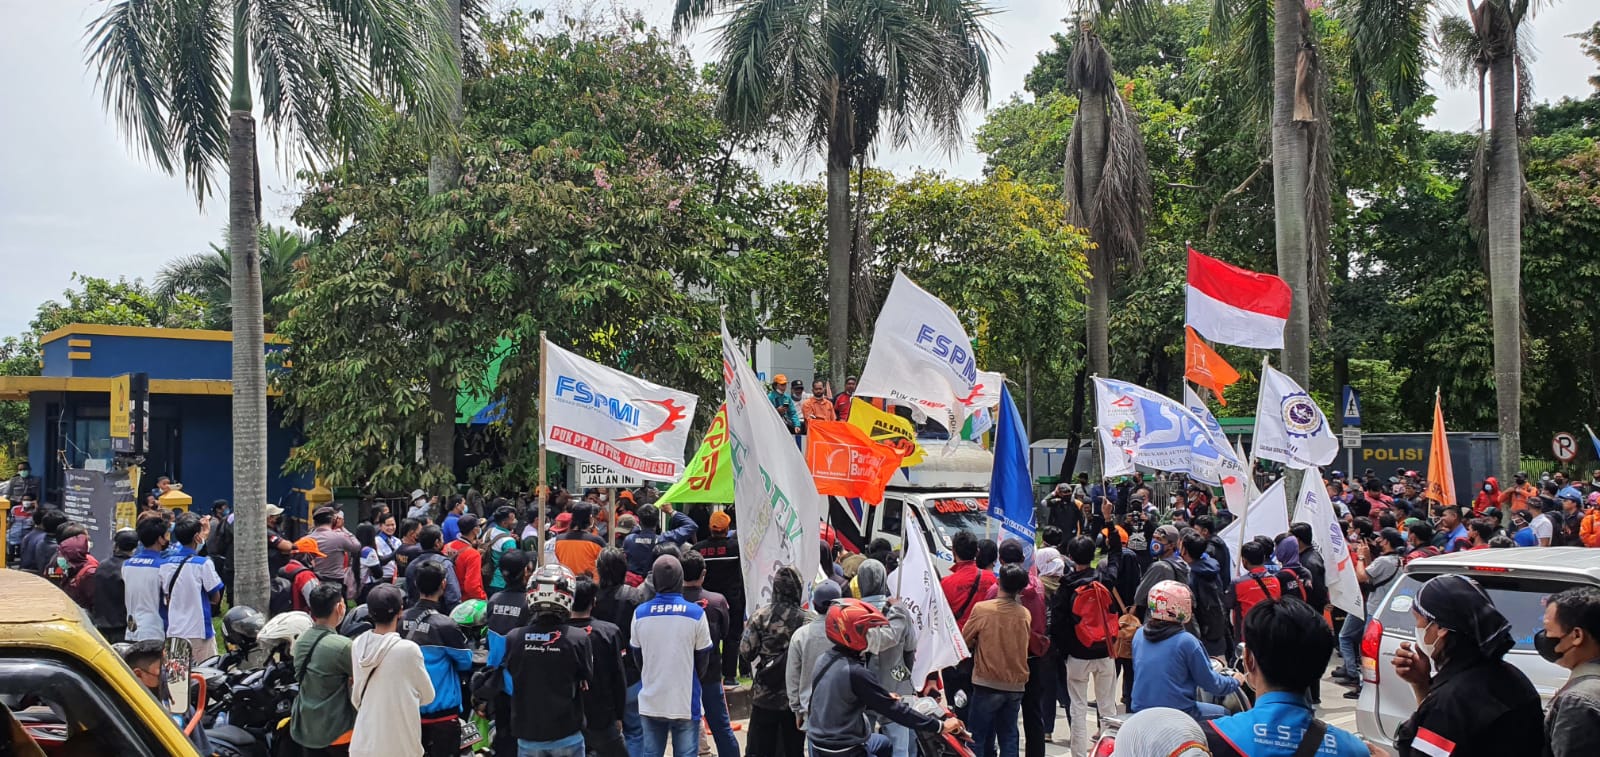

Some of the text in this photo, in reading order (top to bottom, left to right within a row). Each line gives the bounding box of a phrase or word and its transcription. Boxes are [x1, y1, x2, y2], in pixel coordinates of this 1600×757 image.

[916, 323, 977, 387] FSPM
[555, 375, 641, 427] FSPMI
[551, 427, 573, 444] PUK
[574, 434, 589, 449] PT.
[623, 454, 674, 476] INDONESIA
[1363, 448, 1423, 461] POLISI
[1558, 436, 1571, 456] P
[851, 450, 880, 467] Partai
[586, 475, 634, 484] JALAN INI
[650, 604, 687, 613] FSPMI
